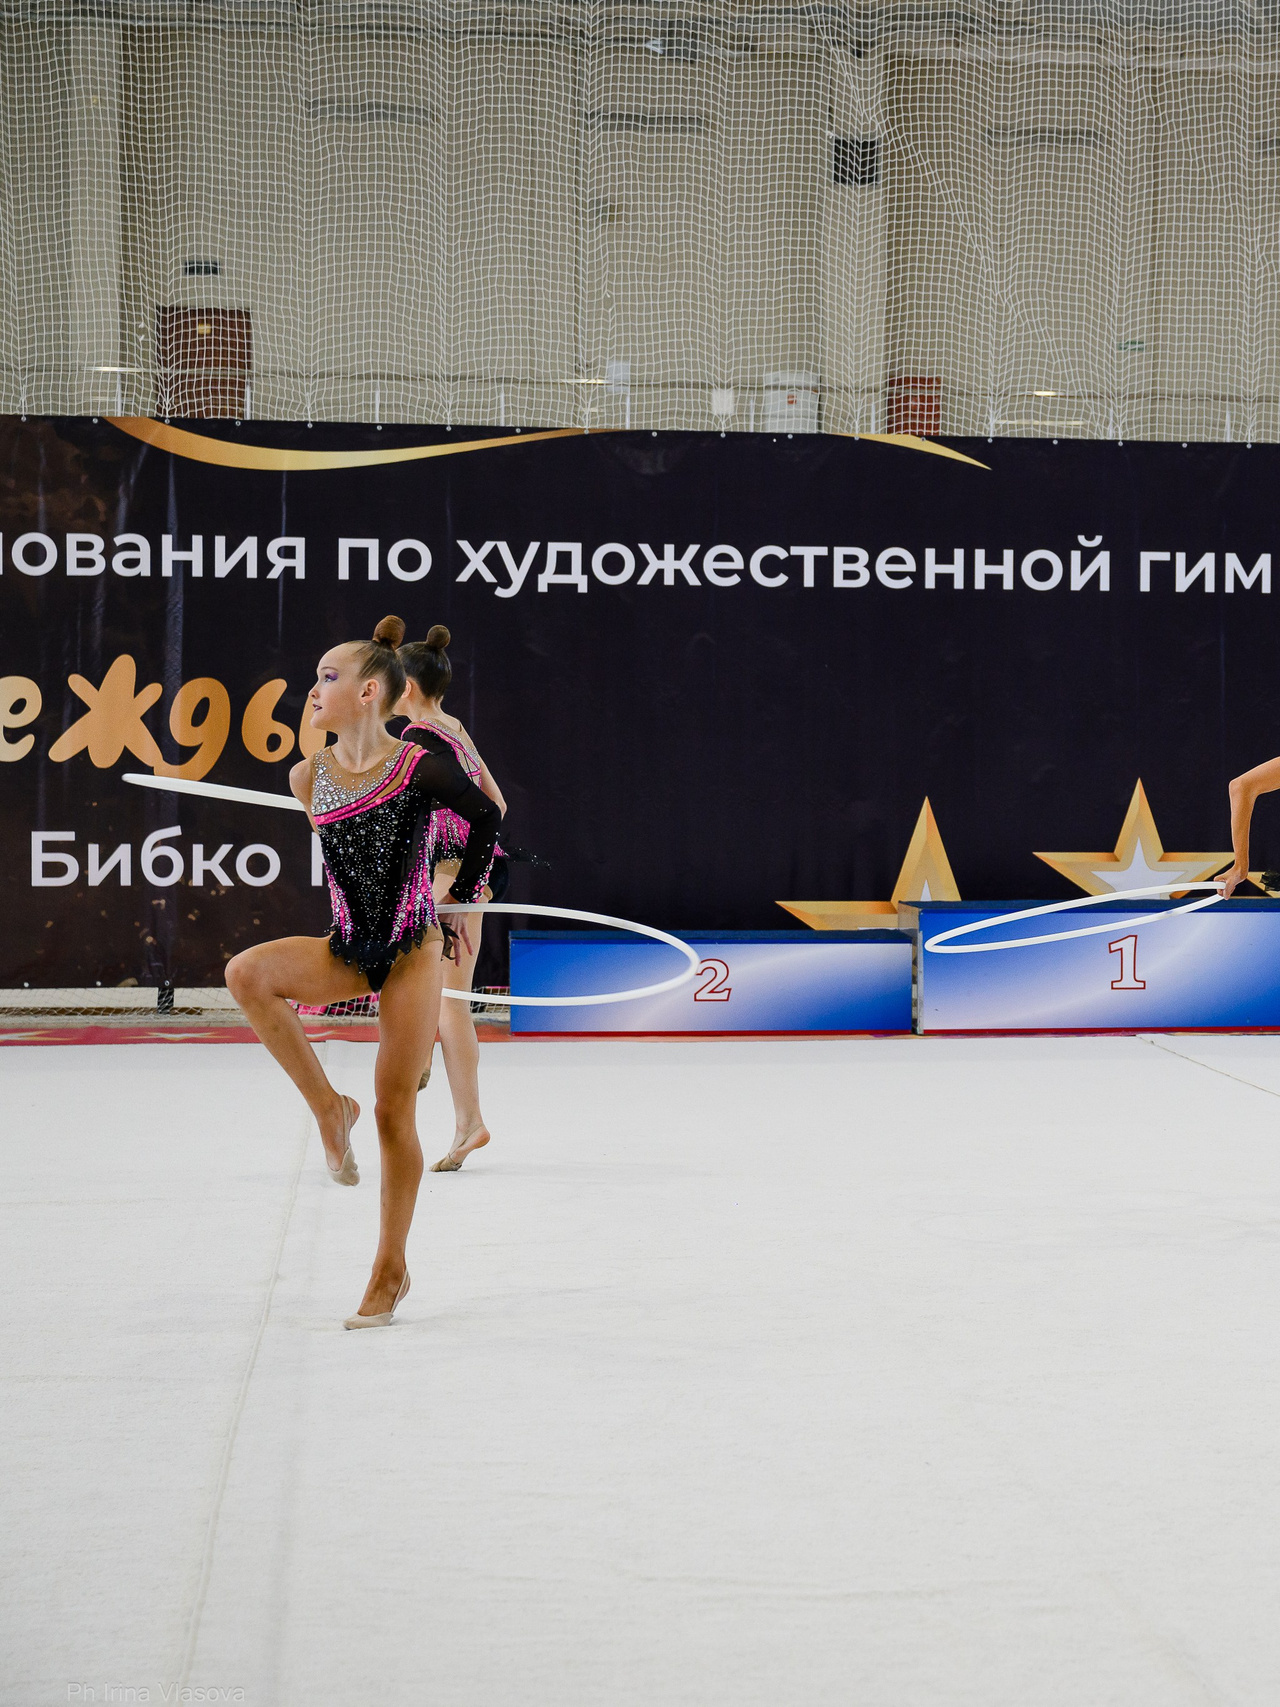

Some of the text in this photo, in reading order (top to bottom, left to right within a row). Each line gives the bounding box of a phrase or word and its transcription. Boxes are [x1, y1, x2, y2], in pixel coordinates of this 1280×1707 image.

[0, 532, 306, 580] ования
[338, 537, 433, 582] по
[455, 534, 1110, 598] художественной
[31, 825, 281, 888] Бибко
[693, 957, 732, 1003] 2
[1108, 934, 1147, 991] 1
